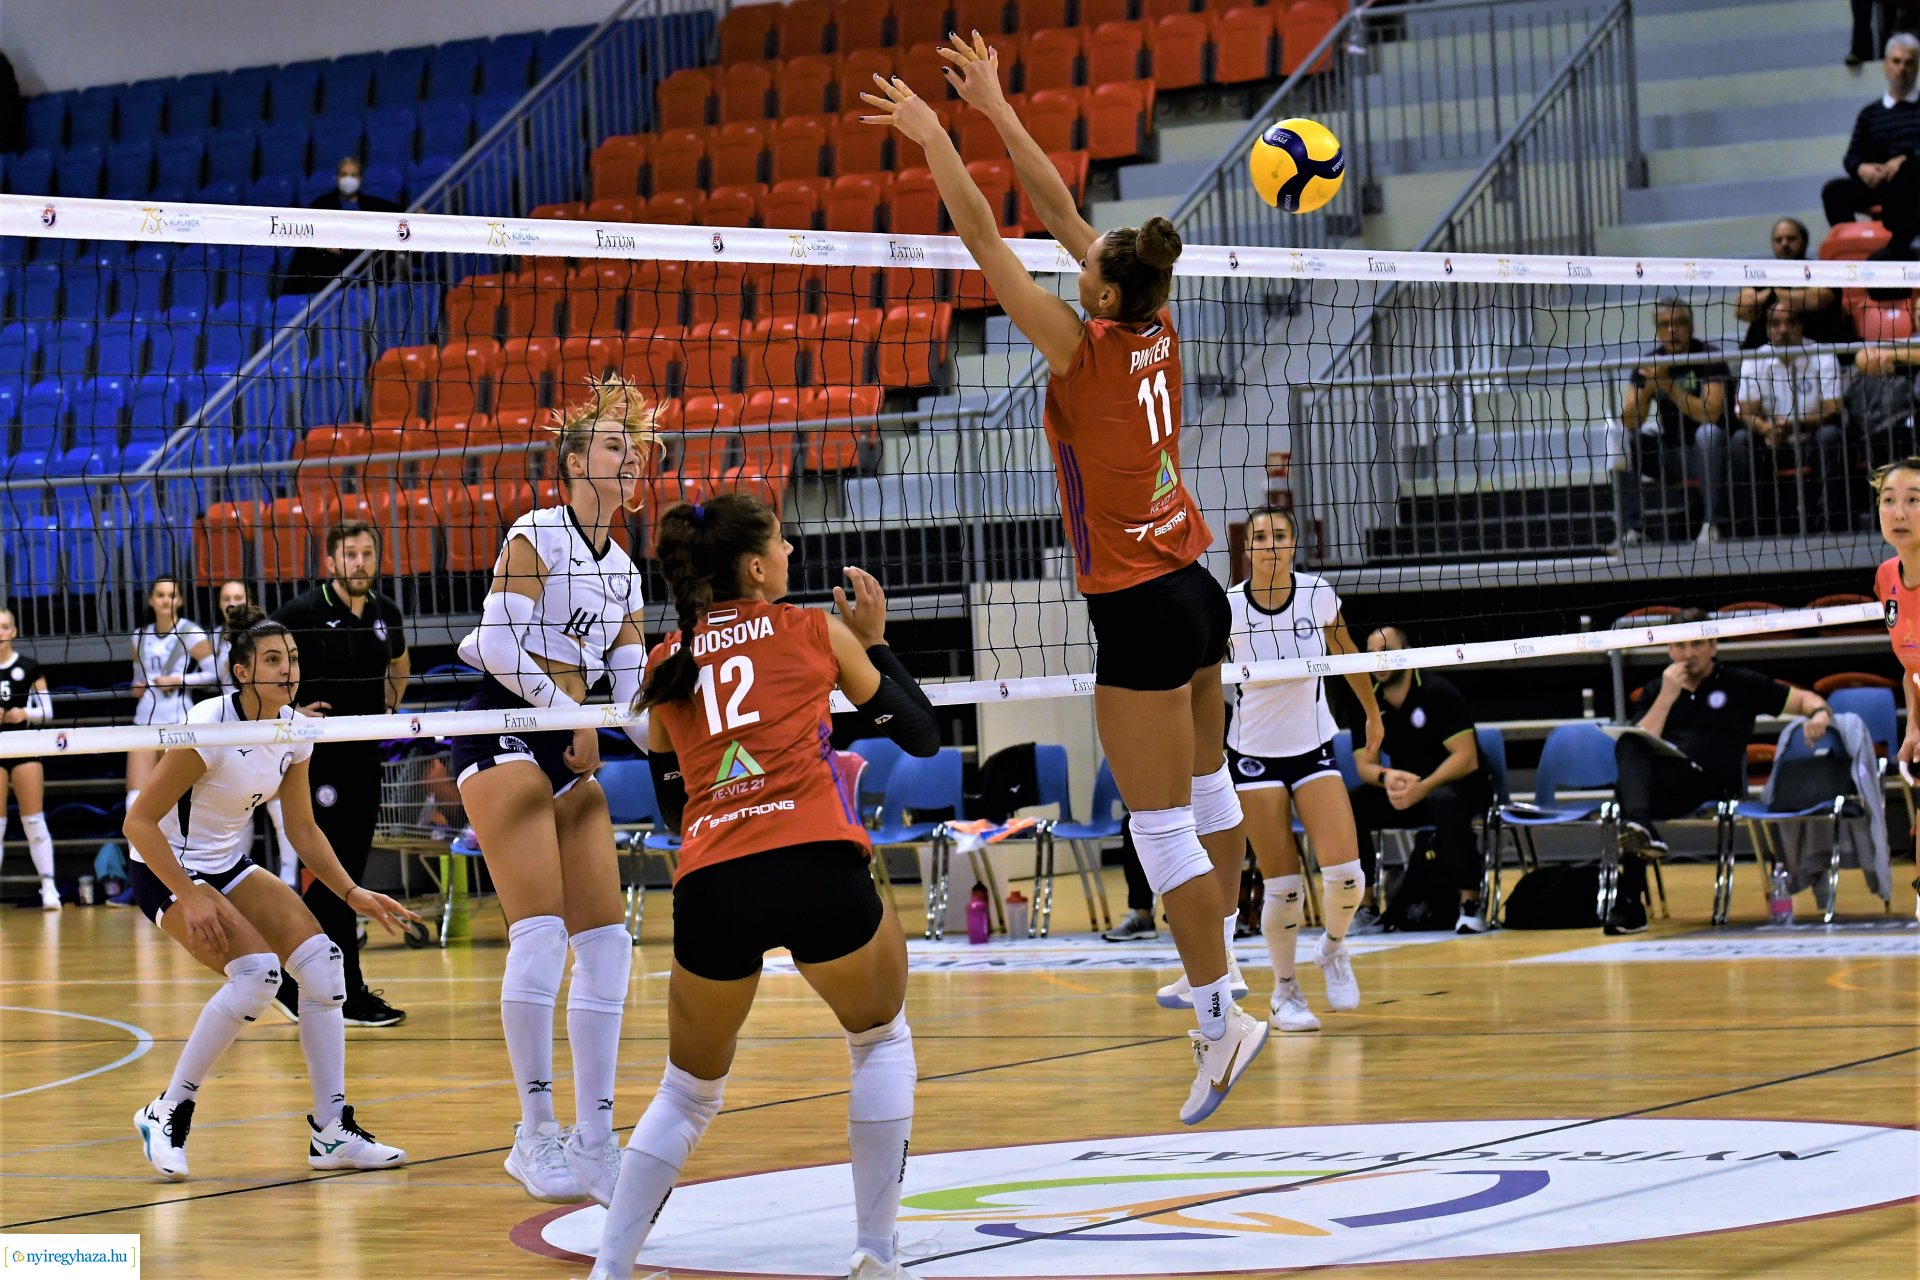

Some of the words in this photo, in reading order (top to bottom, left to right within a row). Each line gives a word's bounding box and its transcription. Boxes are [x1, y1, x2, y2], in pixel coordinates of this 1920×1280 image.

[269, 215, 315, 236] FATUM
[595, 229, 636, 248] FATUM
[889, 240, 925, 259] FATUM
[1368, 257, 1396, 274] FATUM
[1129, 335, 1171, 375] PINTÉR
[1137, 369, 1173, 446] 11
[562, 607, 598, 637] 14
[670, 615, 775, 657] RDOSOVA
[1307, 660, 1331, 675] FATUM
[694, 655, 761, 737] 12
[503, 712, 537, 729] FATUM
[158, 728, 197, 745] FATUM
[709, 800, 795, 829] BESTRONG
